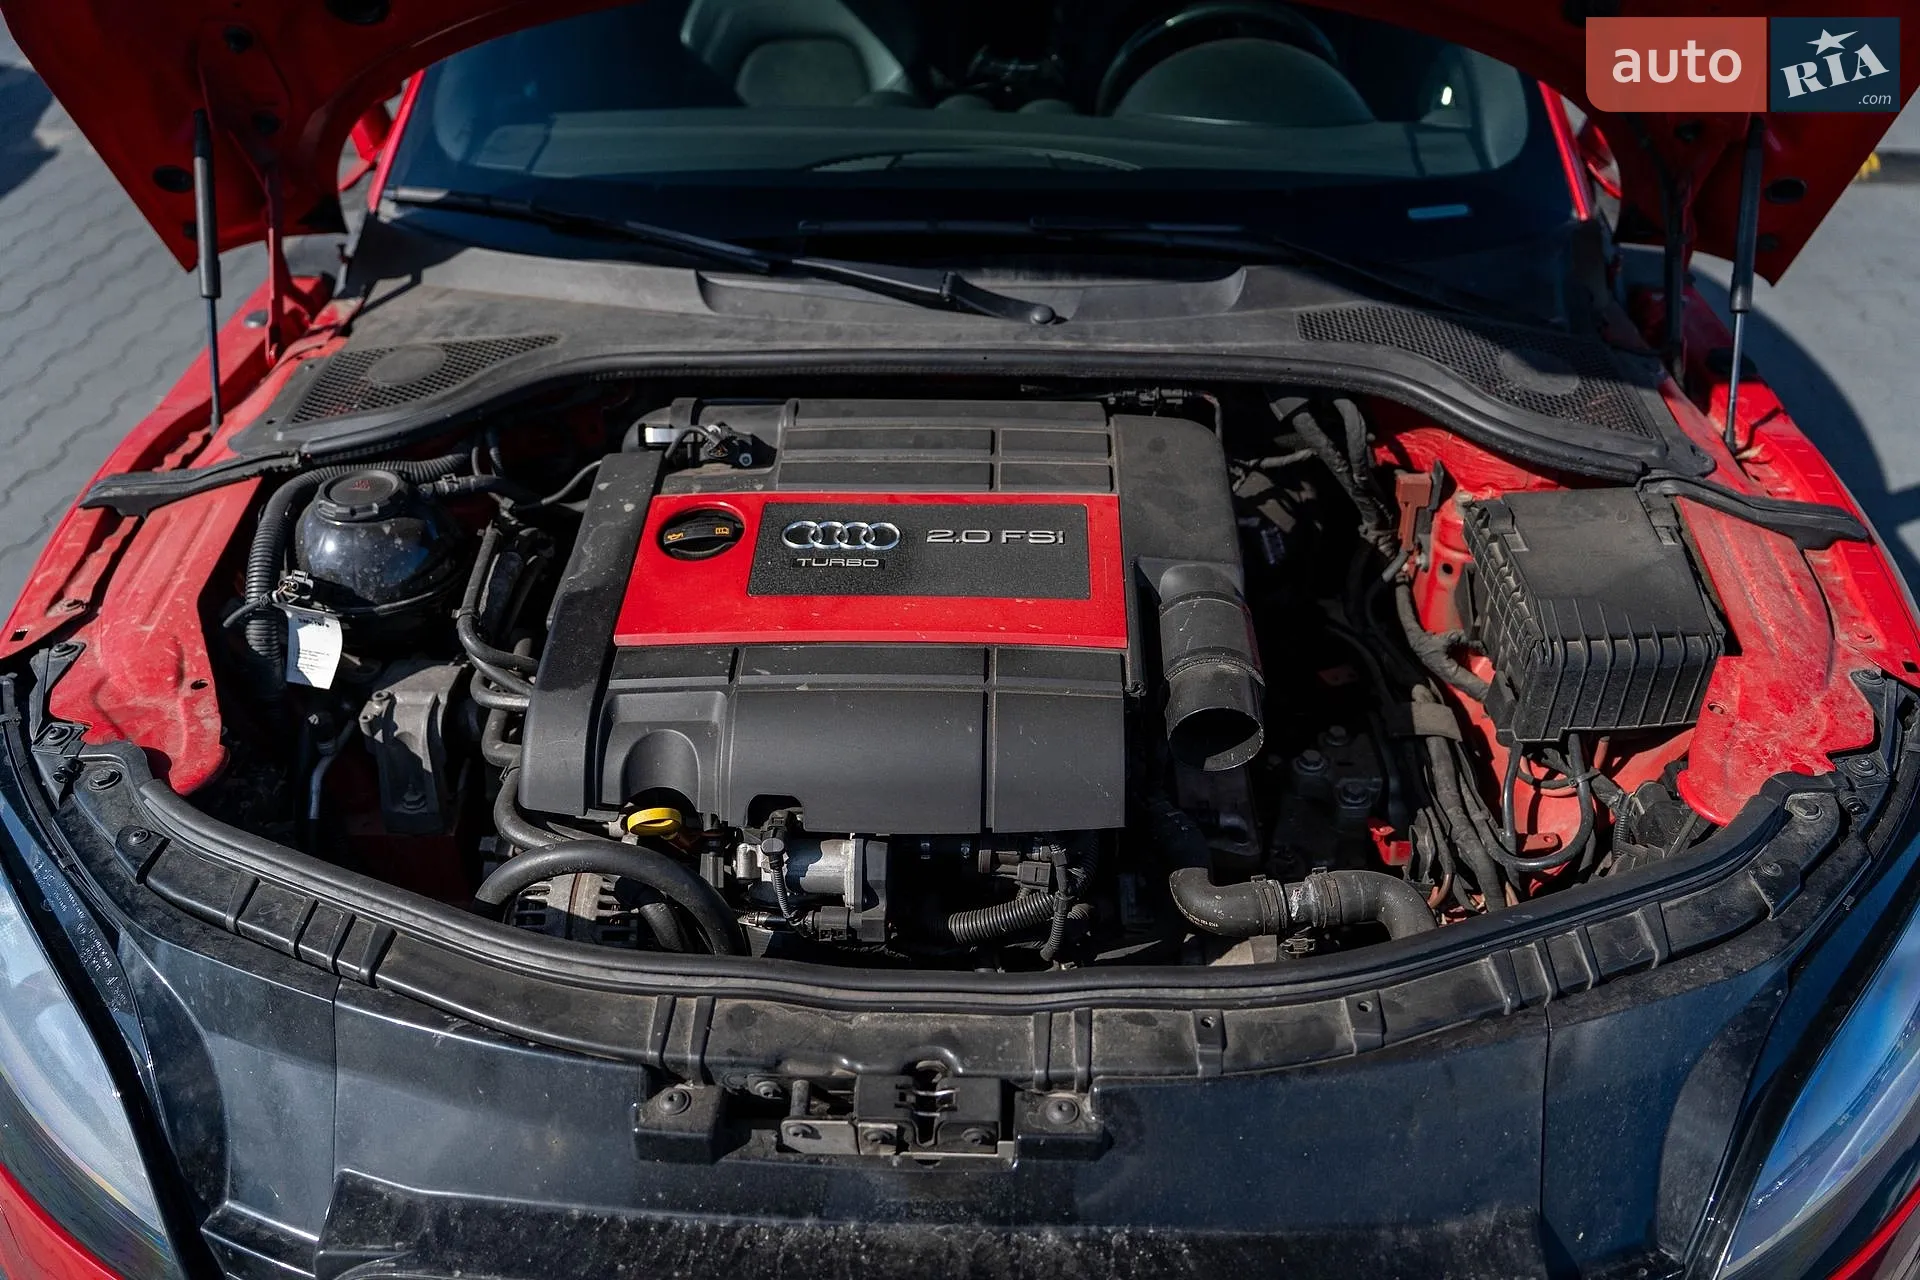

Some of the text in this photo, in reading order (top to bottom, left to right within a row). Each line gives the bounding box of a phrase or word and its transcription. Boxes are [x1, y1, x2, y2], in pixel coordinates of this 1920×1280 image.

[926, 529, 1065, 545] 2.0 FSI
[796, 557, 880, 568] TURBO
